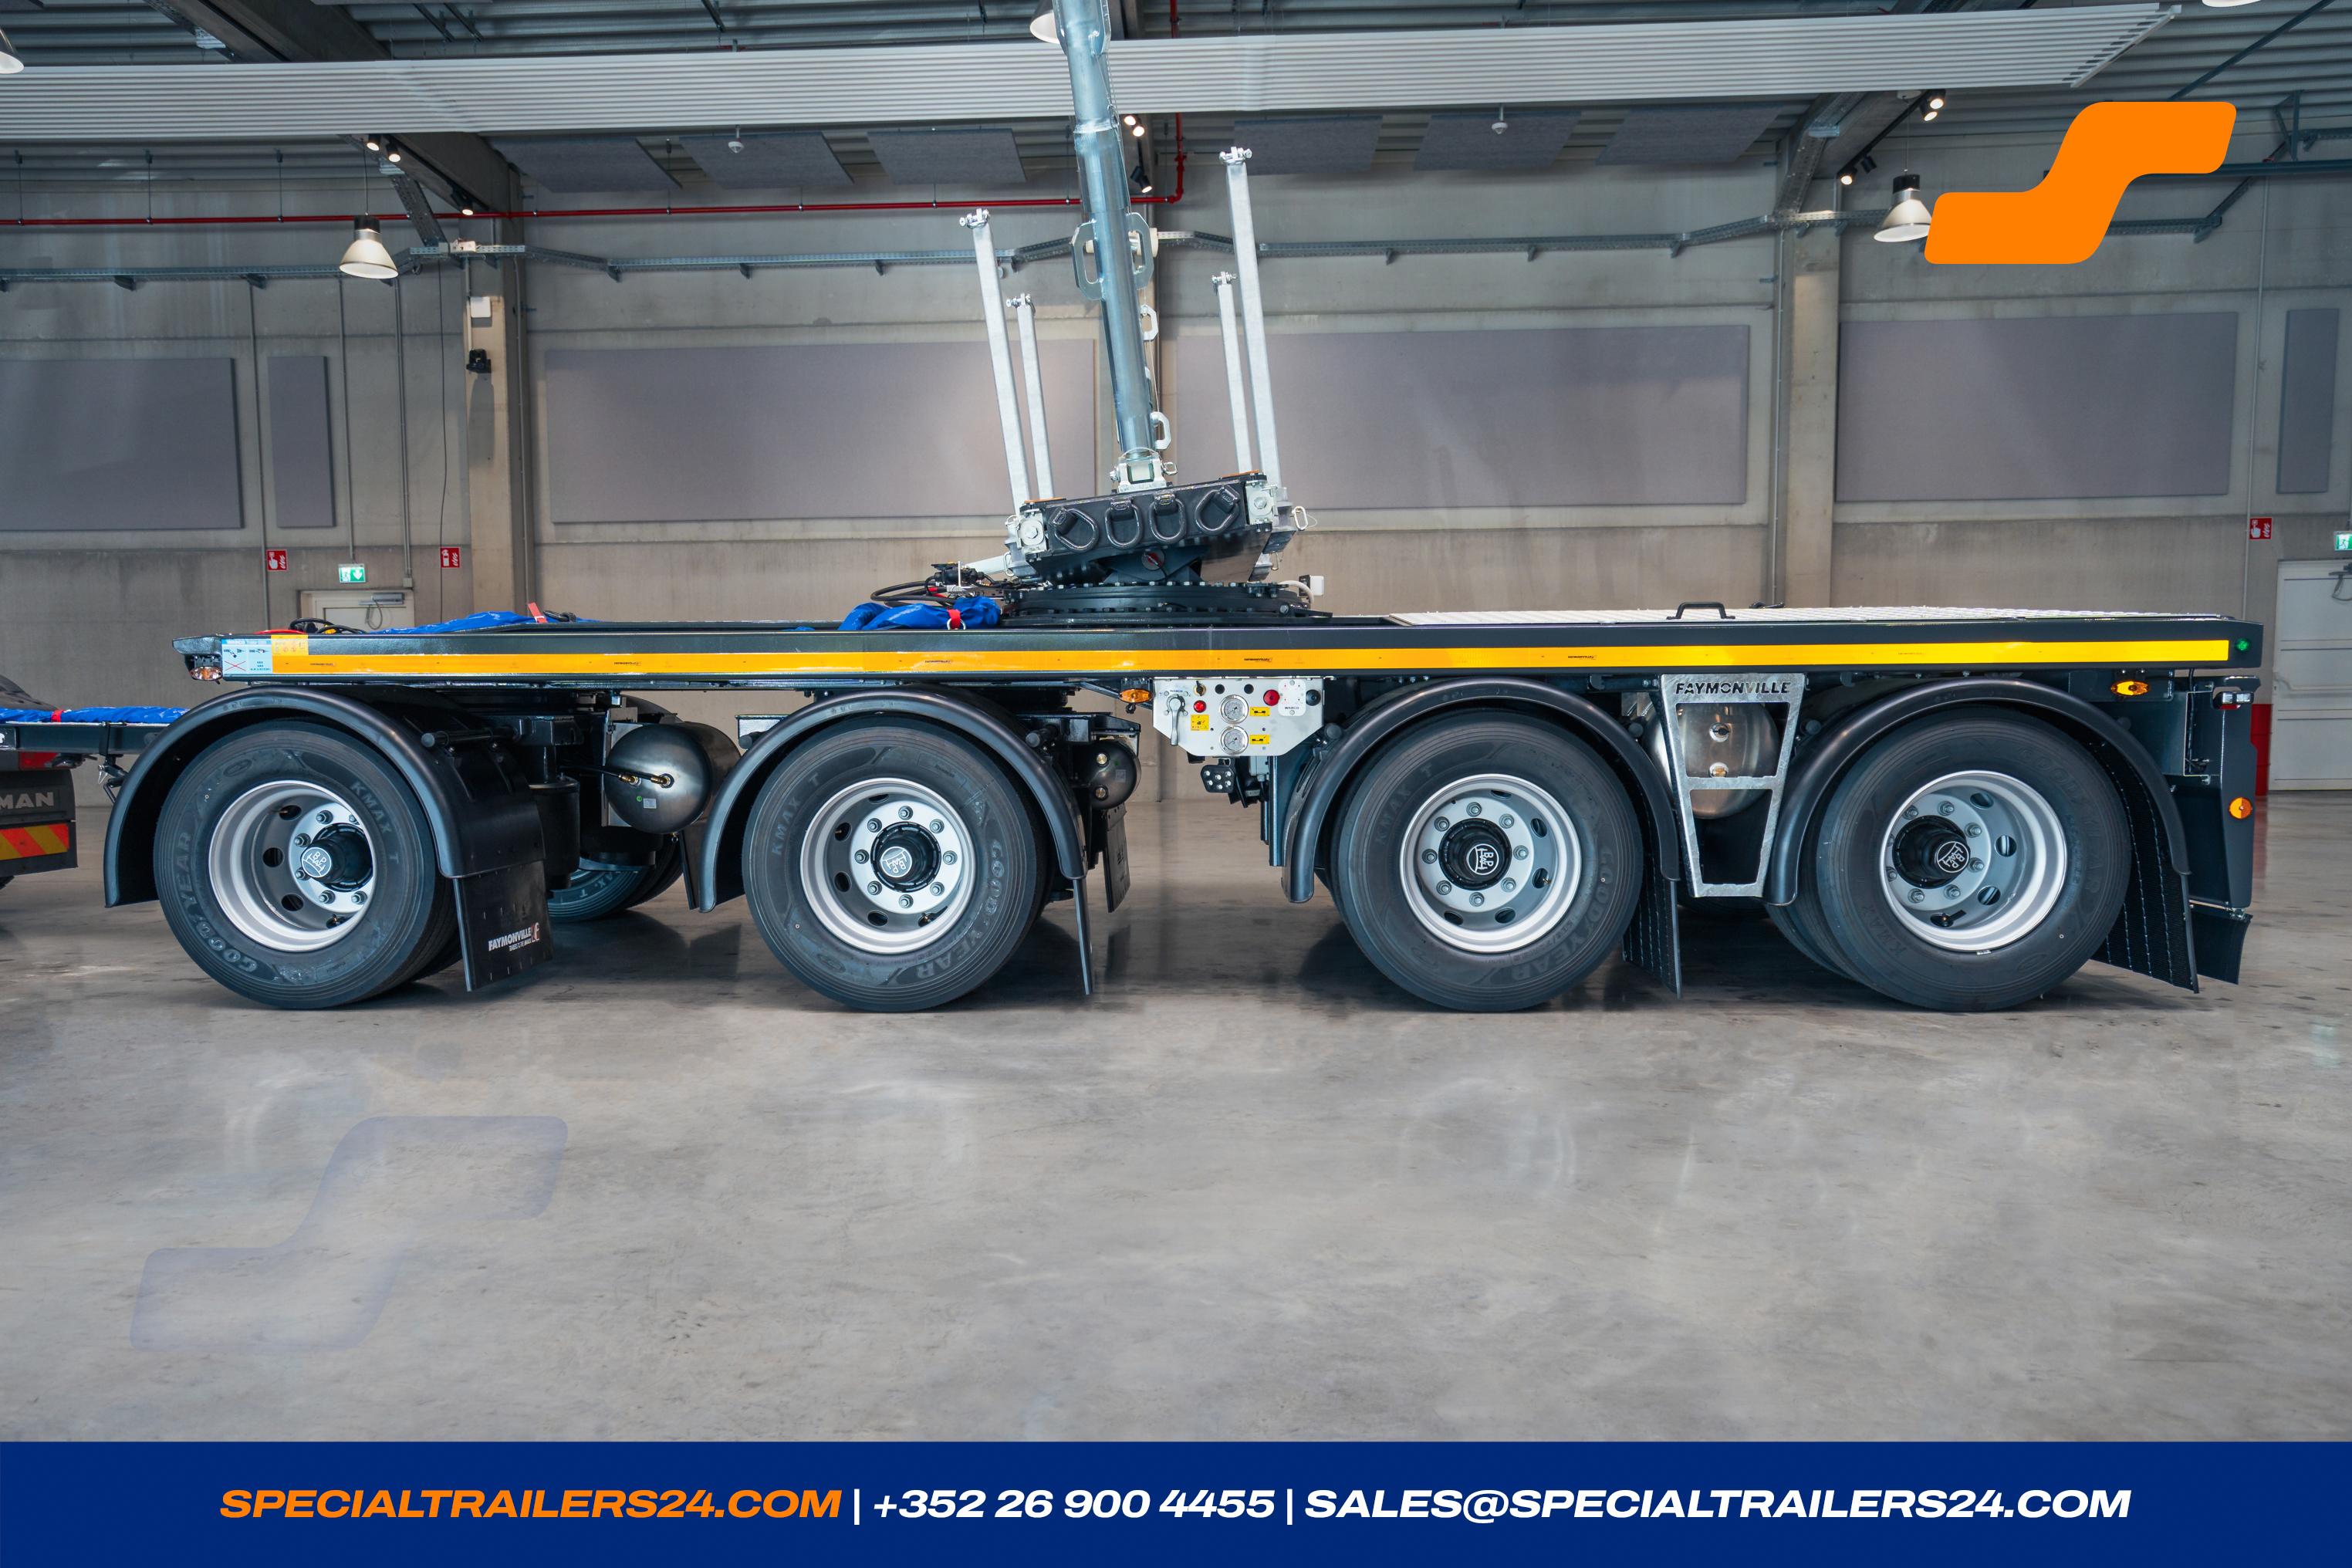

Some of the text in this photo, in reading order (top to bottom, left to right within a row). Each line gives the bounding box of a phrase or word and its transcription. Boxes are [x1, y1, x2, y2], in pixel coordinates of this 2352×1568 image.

[1675, 682, 1791, 694] FAYMONVILLE
[0, 792, 54, 809] MAN
[351, 781, 392, 834] KMAX
[1374, 786, 1411, 846] KMAX
[772, 797, 802, 856] KMAX
[488, 927, 532, 951] FAYMONVILLE
